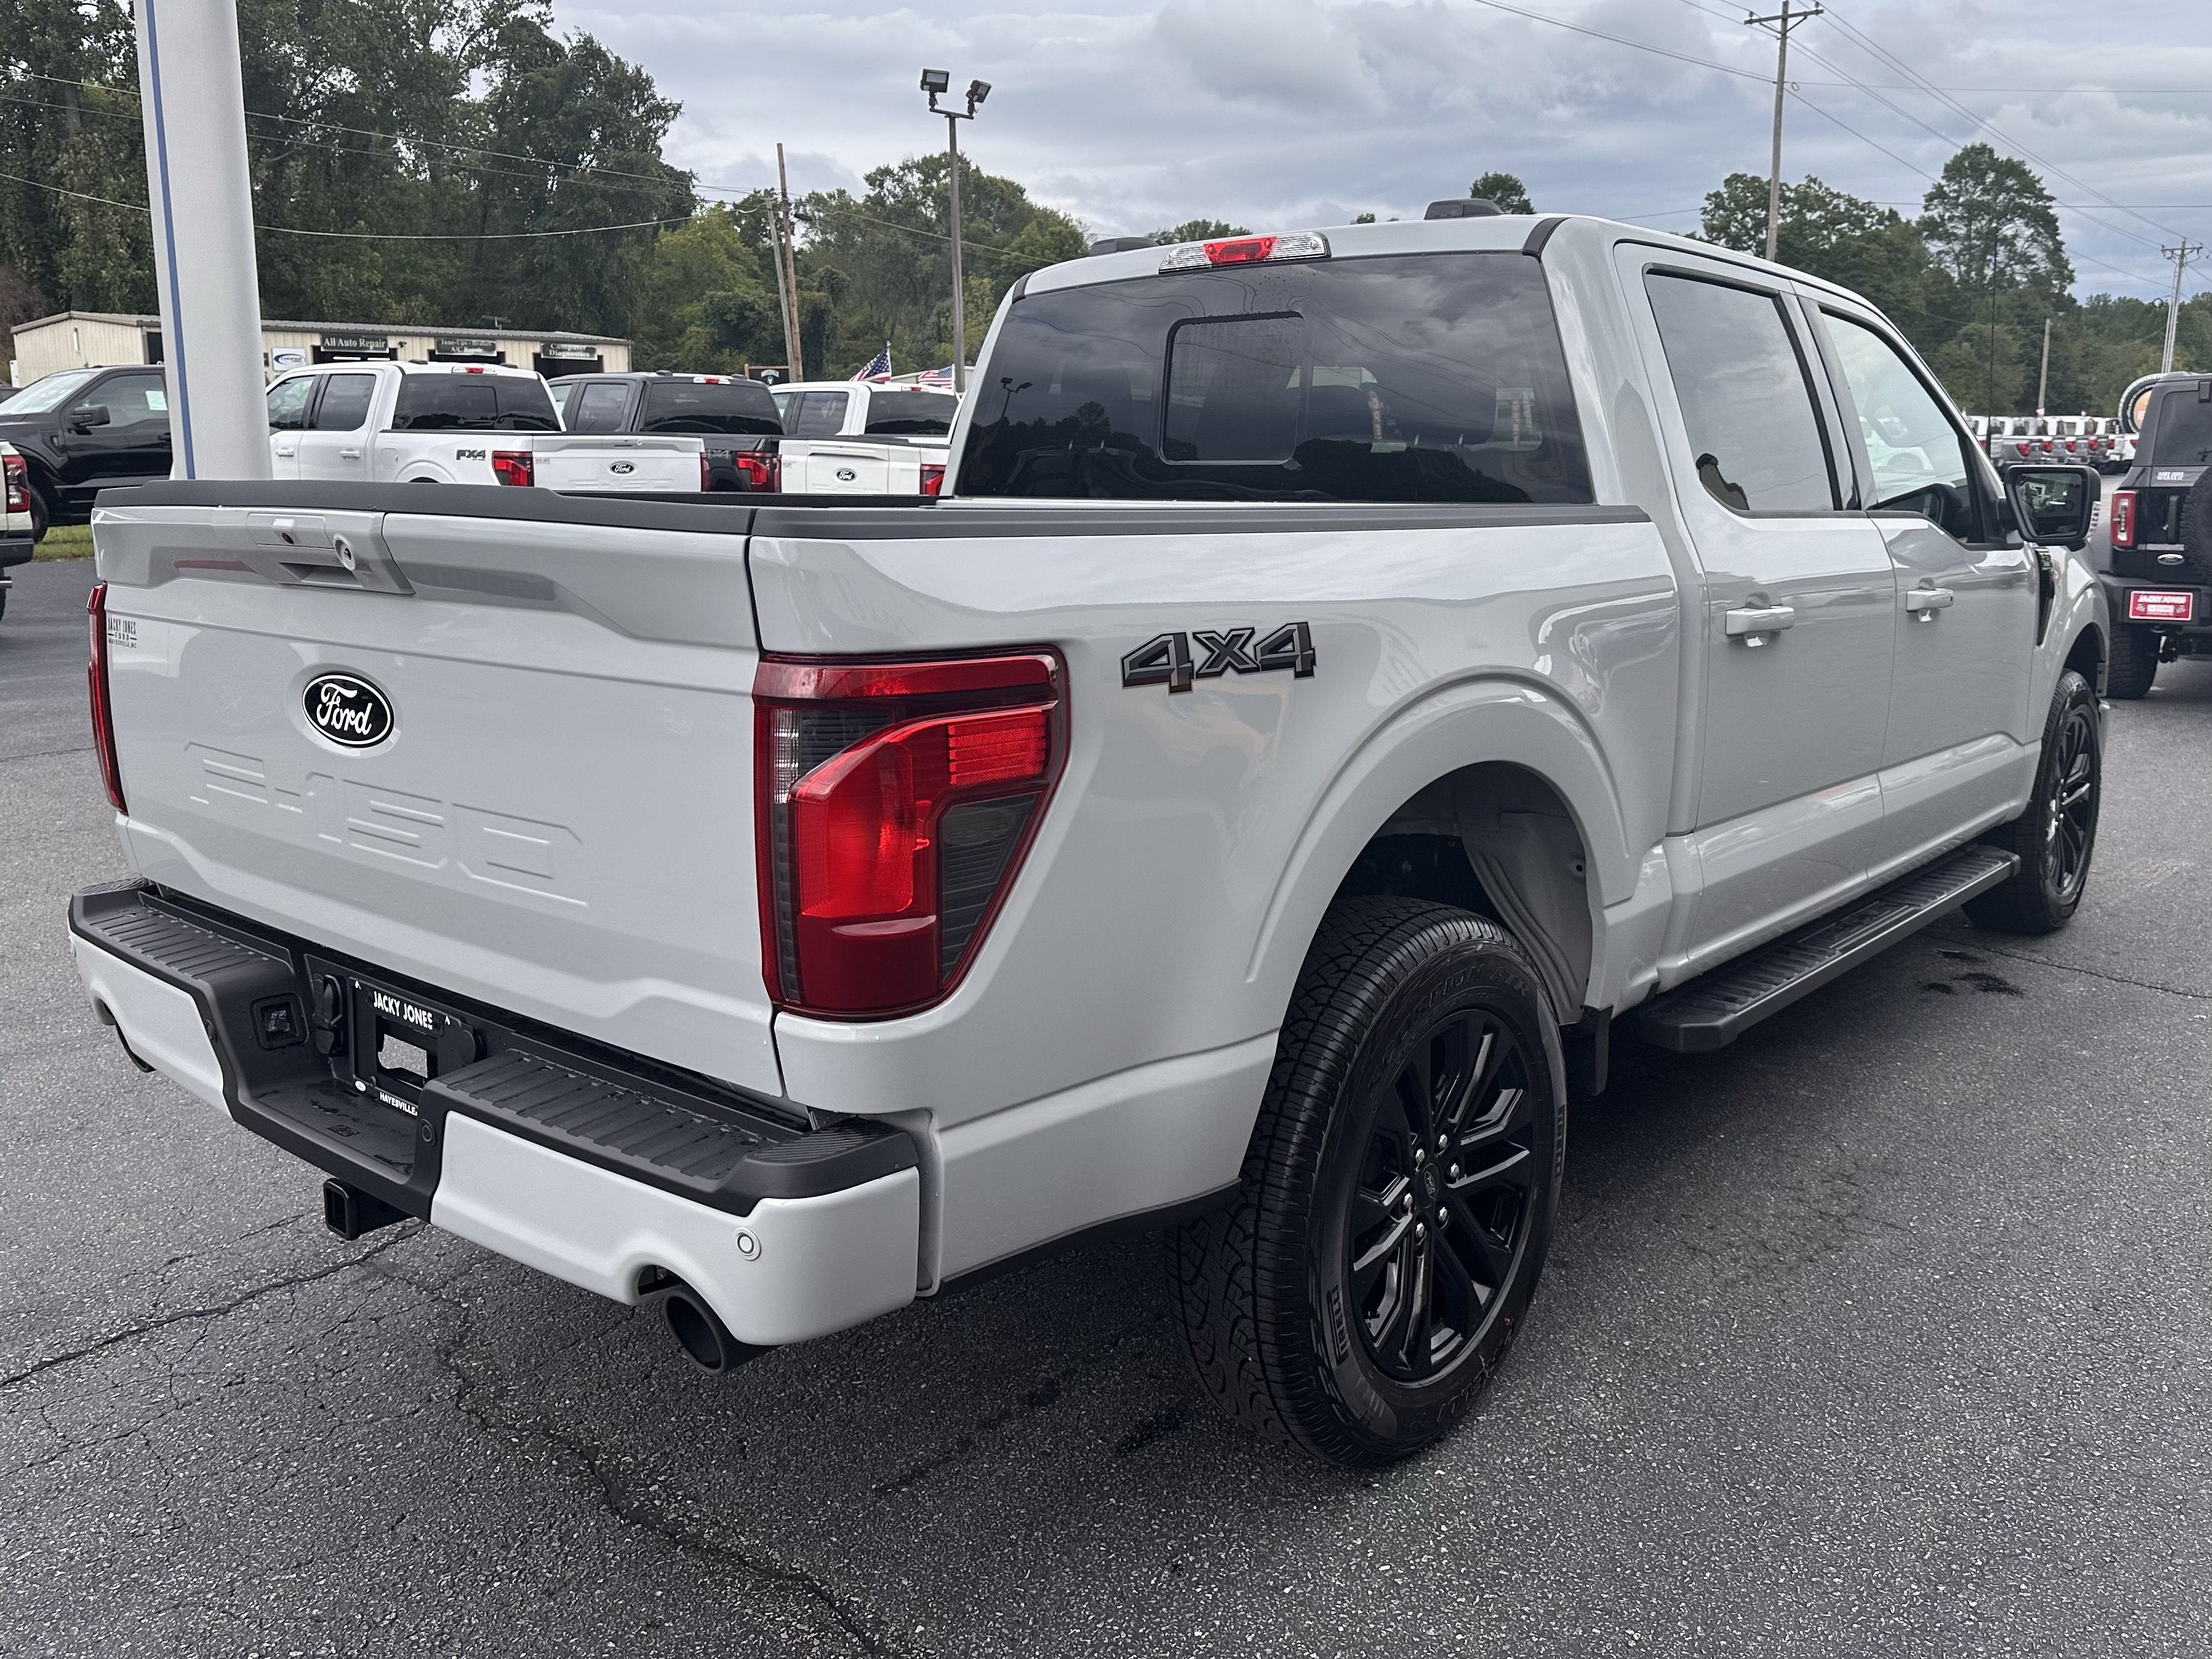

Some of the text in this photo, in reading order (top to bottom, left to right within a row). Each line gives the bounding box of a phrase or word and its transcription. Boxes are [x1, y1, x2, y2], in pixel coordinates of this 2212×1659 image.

[323, 337, 386, 349] All Auto Repair
[456, 449, 486, 460] FX4
[108, 617, 136, 635] JACKY JONES
[1120, 621, 1317, 696] 4X4
[316, 682, 372, 736] Ford
[1489, 966, 1531, 997] ATR
[373, 991, 433, 1031] JACKY JONES
[1326, 1284, 1349, 1367] PIRELLI
